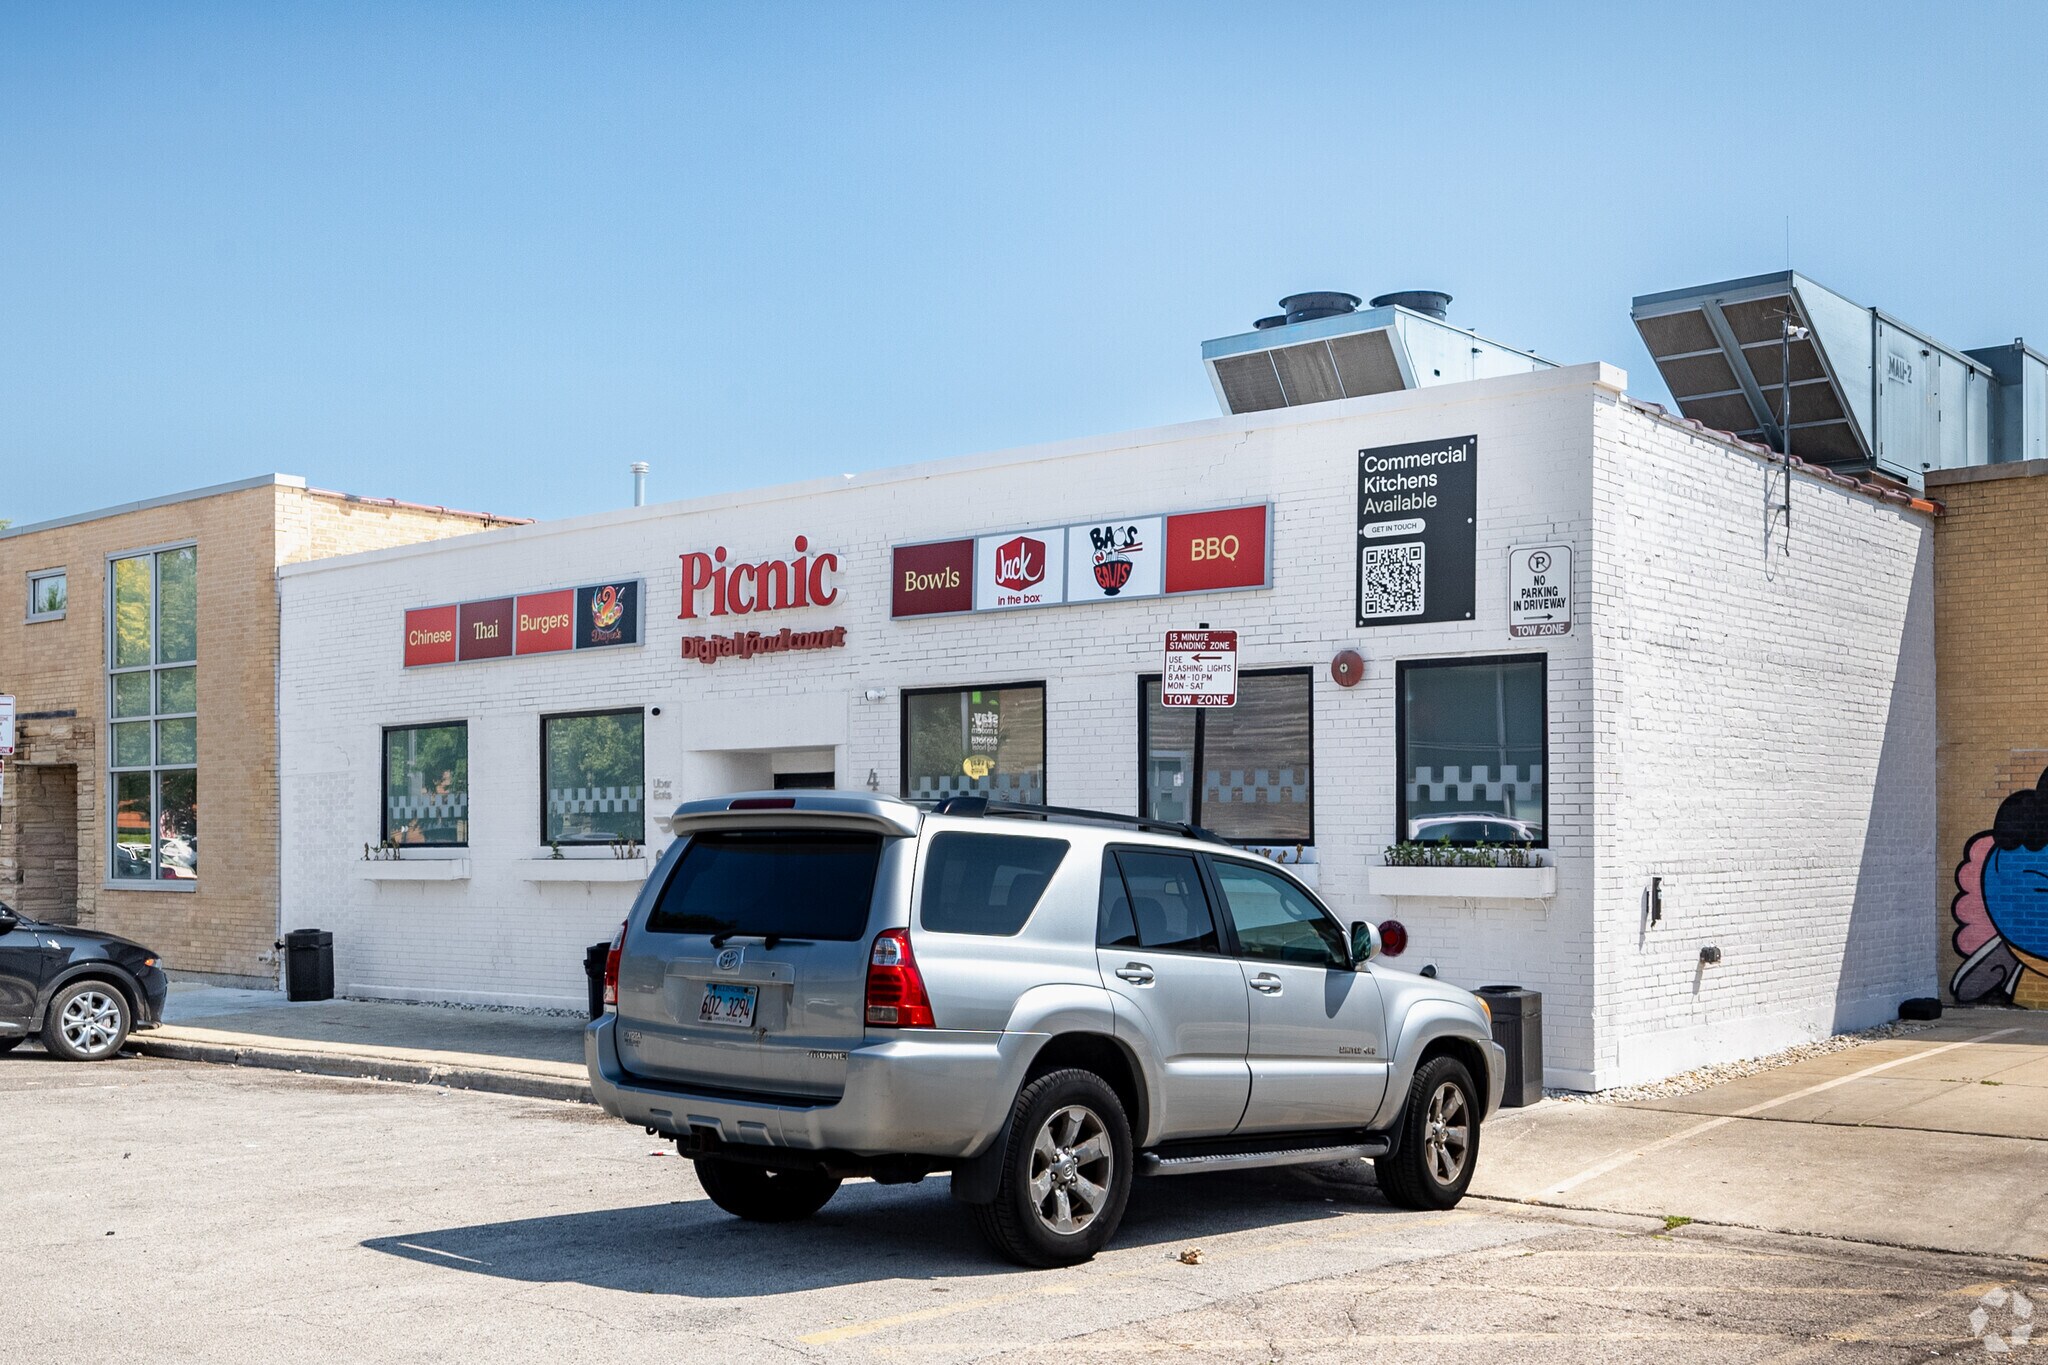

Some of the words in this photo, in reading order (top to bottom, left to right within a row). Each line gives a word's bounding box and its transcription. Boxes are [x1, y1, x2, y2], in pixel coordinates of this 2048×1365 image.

[1364, 444, 1467, 473] Commercial
[1364, 473, 1438, 494] Kitchens
[1363, 492, 1438, 515] Available
[1371, 525, 1385, 533] GET
[1385, 524, 1393, 532] IN
[1393, 522, 1417, 531] TOUCH
[1191, 534, 1240, 562] BBQ
[996, 541, 1044, 584] Jack
[677, 535, 838, 620] Picnic
[904, 566, 960, 593] Bowls
[1533, 575, 1546, 586] NO
[1521, 585, 1558, 599] PARKING
[997, 595, 1006, 606] in
[1007, 595, 1022, 605] the
[1023, 593, 1041, 604] box
[1513, 600, 1522, 611] IN
[1523, 597, 1566, 611] DRIVEWAY
[473, 619, 499, 640] Thai
[520, 613, 569, 634] Burgers
[1516, 625, 1538, 636] TOW
[1539, 623, 1565, 635] ZONE
[409, 629, 452, 647] Chinese
[1169, 633, 1178, 641] 15
[1181, 633, 1209, 641] MINUTE
[682, 632, 744, 664] Digital
[740, 628, 791, 659] food
[789, 626, 848, 650] court
[1169, 641, 1206, 650] STANDING
[1209, 641, 1230, 650] ZONE
[1169, 656, 1183, 664] USE
[1168, 664, 1203, 672] FLASHING
[1206, 664, 1232, 672] LIGHTS
[1201, 674, 1213, 682] PM
[1167, 682, 1184, 690] MON
[1190, 682, 1204, 690] SAT
[1167, 695, 1192, 705] TOW
[1197, 695, 1229, 705] ZONE
[653, 778, 673, 789] Uber
[866, 768, 880, 791] 4
[653, 790, 673, 800] Eats
[701, 994, 722, 1015] 602
[726, 996, 750, 1019] 3294
